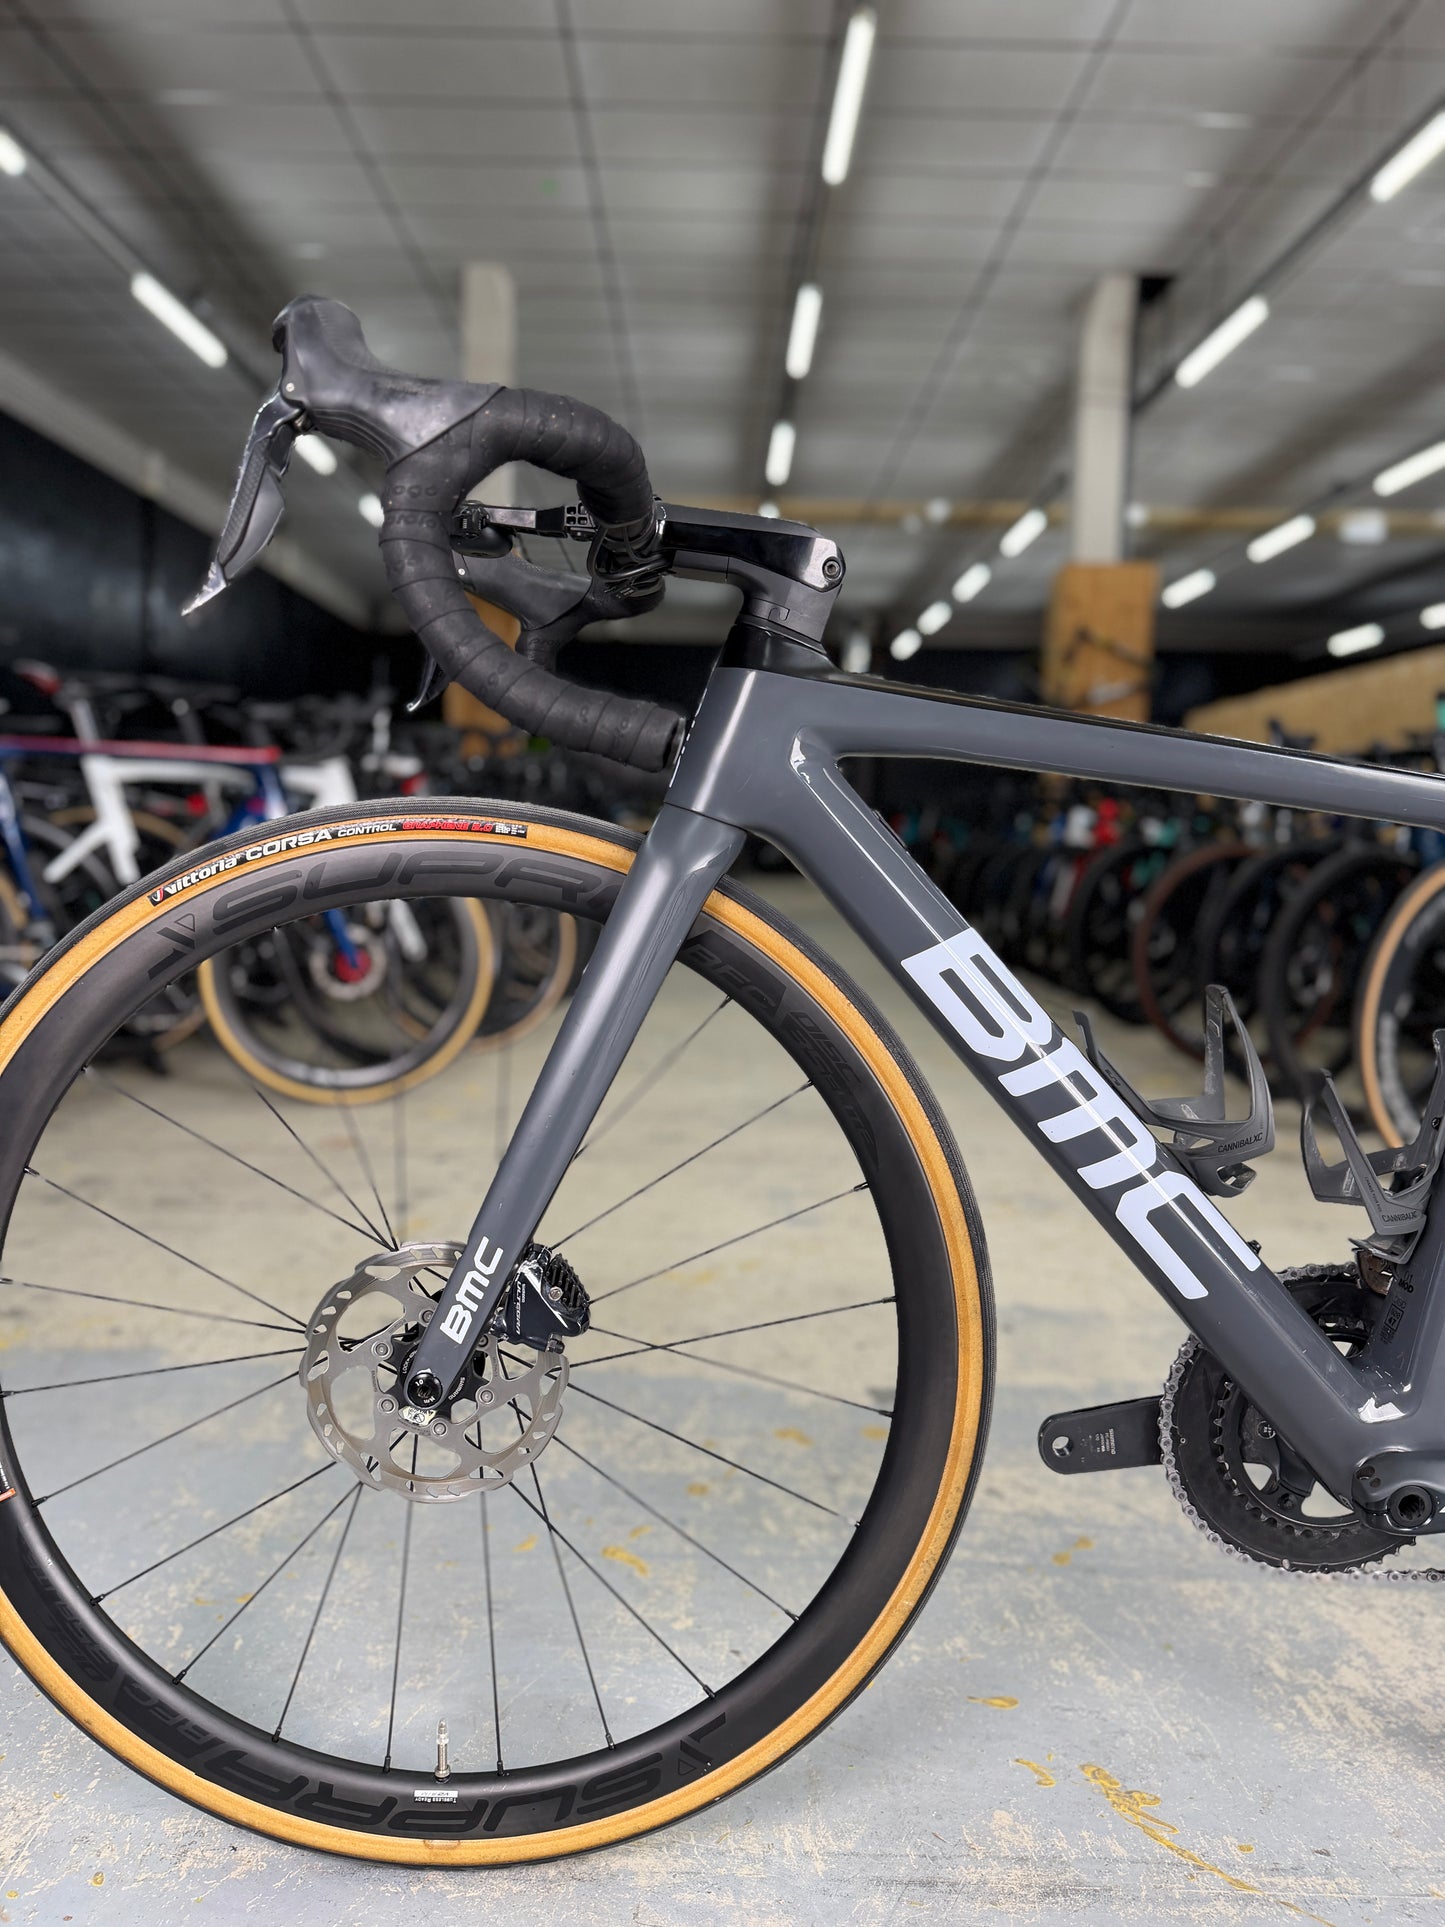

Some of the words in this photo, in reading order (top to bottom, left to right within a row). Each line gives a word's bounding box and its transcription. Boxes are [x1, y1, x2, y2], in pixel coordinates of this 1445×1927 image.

[245, 829, 333, 862] CORSA
[337, 821, 397, 838] CONTROL
[900, 926, 1262, 1300] BMC
[439, 1235, 504, 1345] BMC
[203, 1750, 663, 1832] SUPRA
